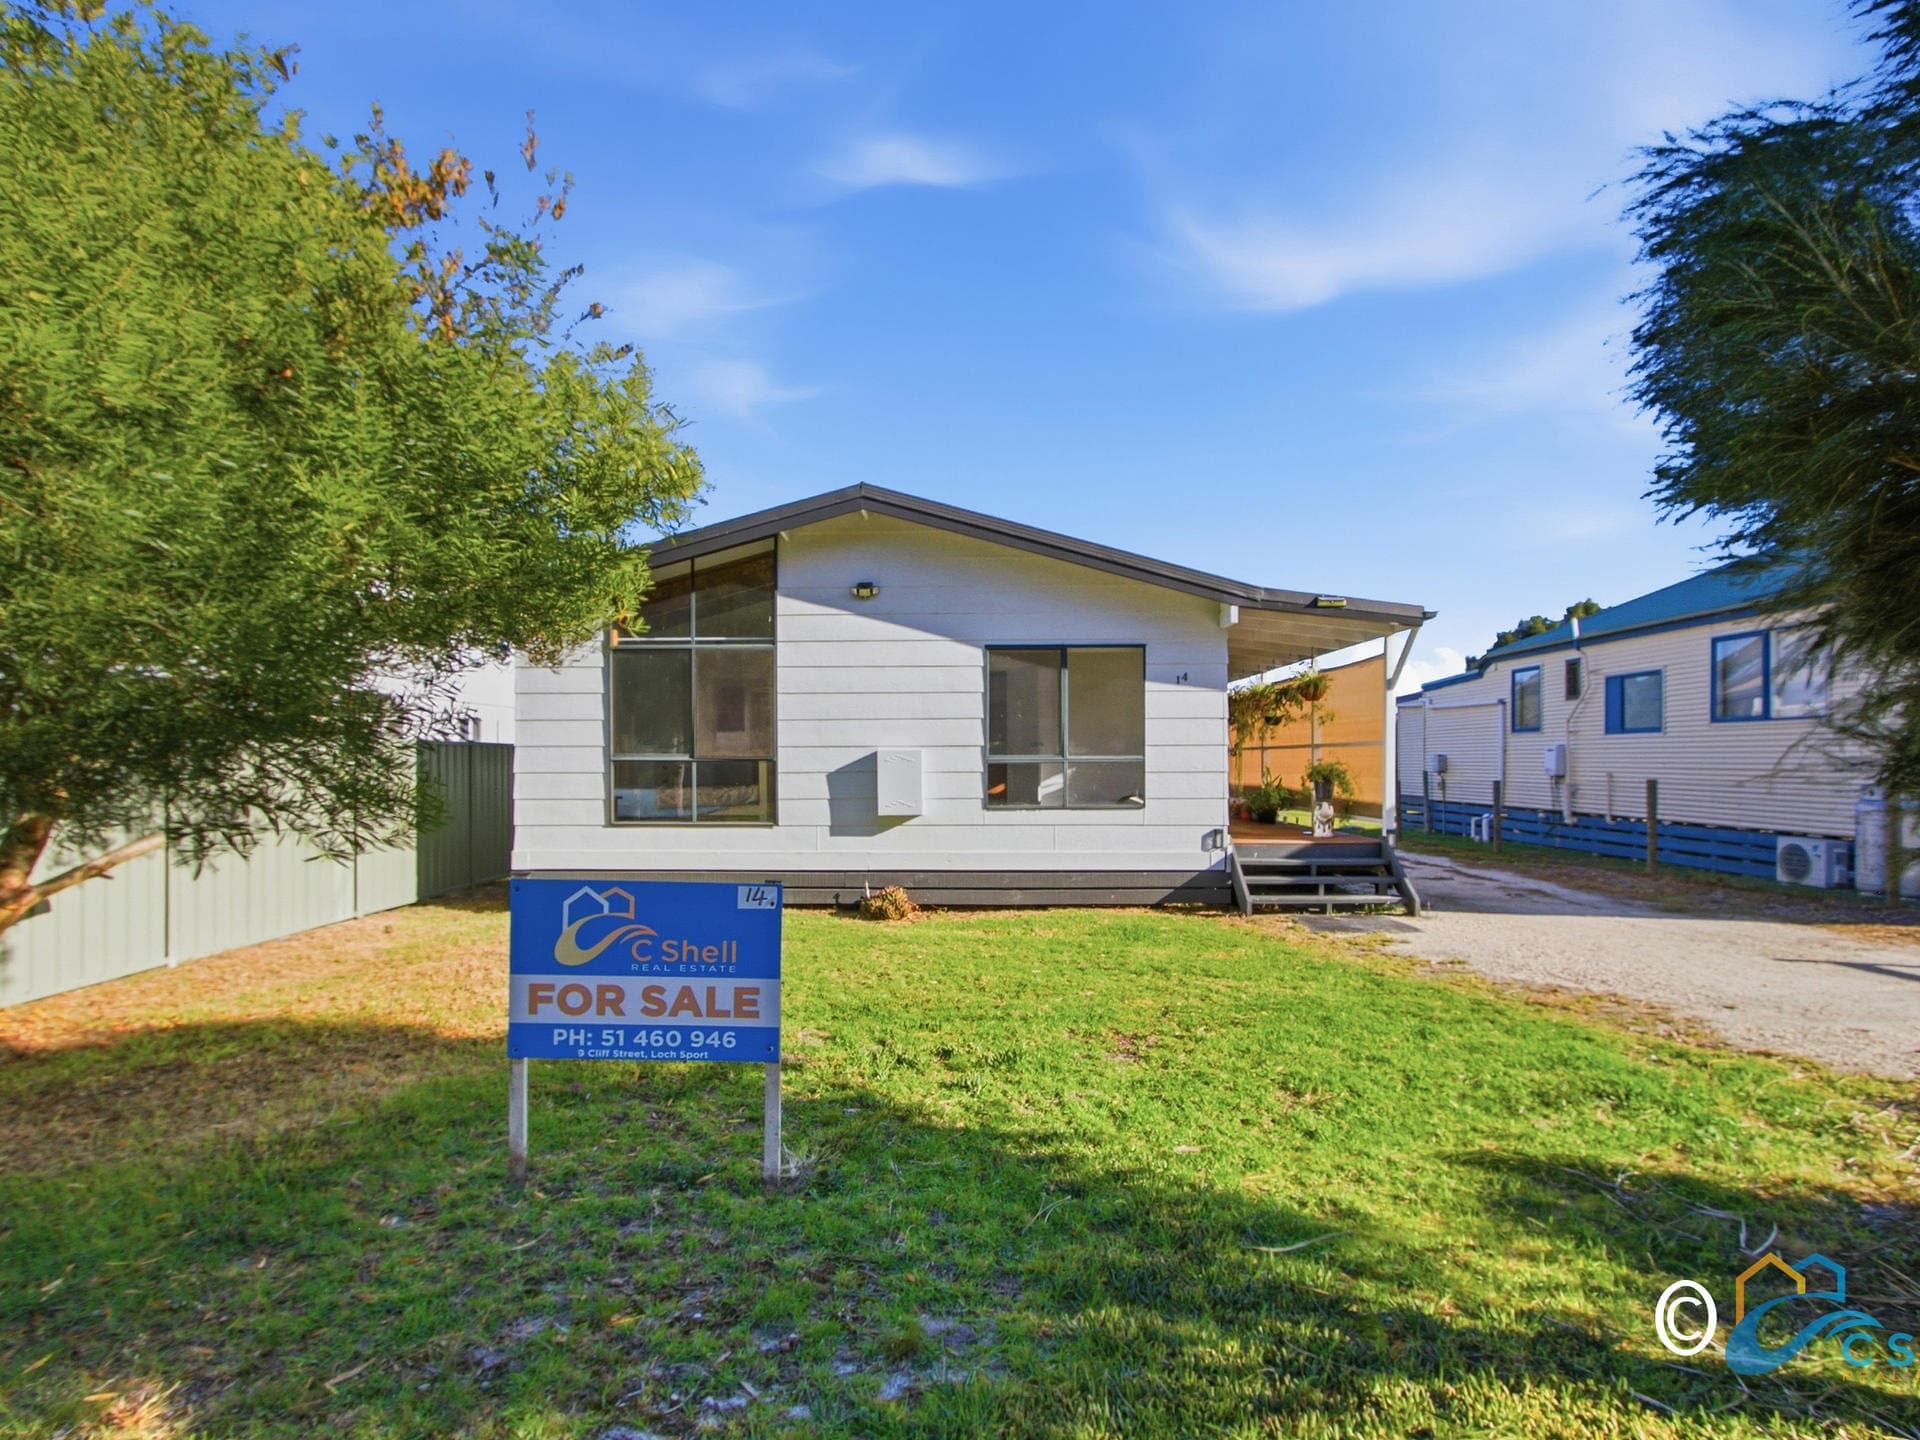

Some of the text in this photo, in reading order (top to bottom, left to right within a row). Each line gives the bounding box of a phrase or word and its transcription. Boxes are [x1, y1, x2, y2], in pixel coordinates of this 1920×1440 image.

[1176, 671, 1188, 685] 14
[631, 940, 737, 964] C Shell
[631, 964, 736, 973] REAL ESTATE
[527, 983, 760, 1020] FOR SALE
[553, 1029, 736, 1048] PH: 51 460 946
[578, 1050, 709, 1060] 9 Cliff Street, Loch Sport
